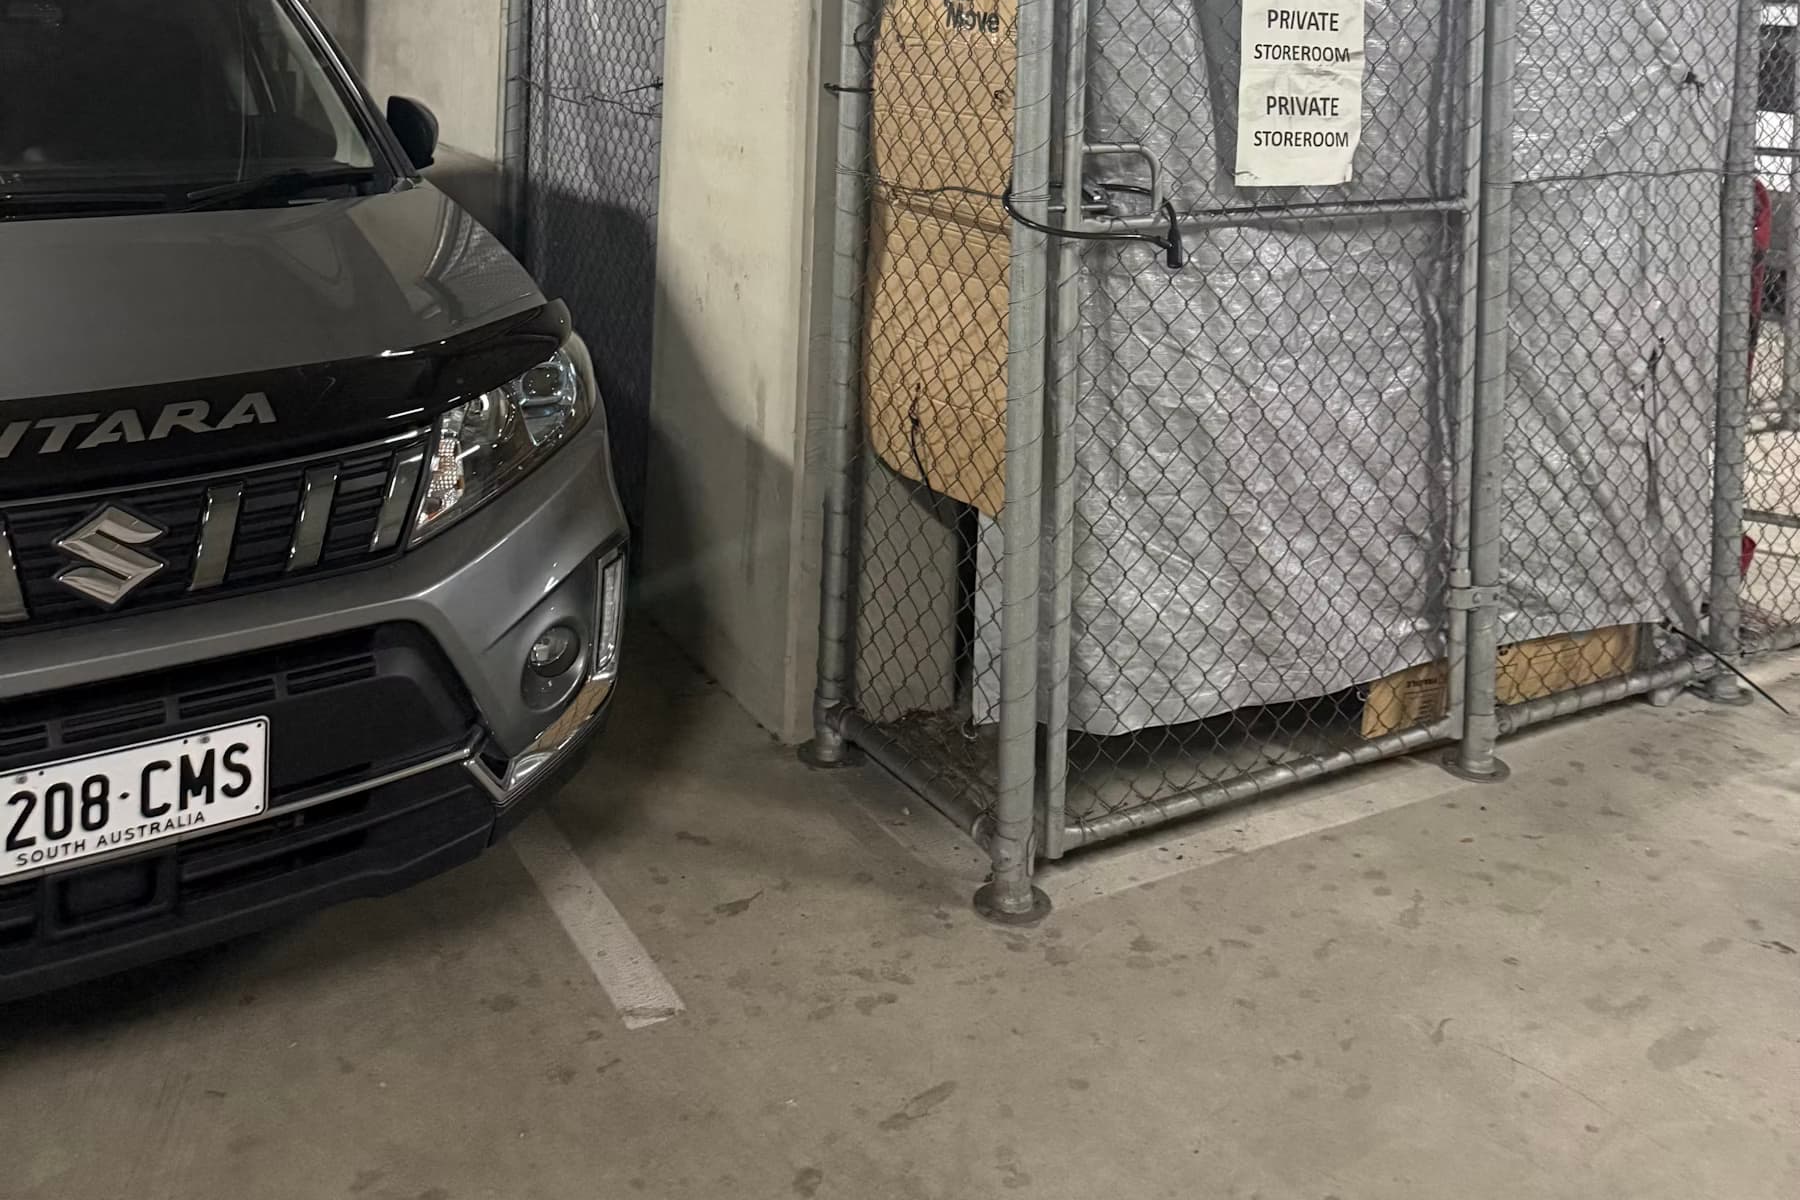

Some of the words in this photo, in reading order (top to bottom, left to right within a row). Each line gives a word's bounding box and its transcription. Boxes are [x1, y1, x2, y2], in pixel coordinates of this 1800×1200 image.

[1267, 9, 1339, 32] PRIVATE
[1253, 43, 1351, 62] STOREROOM
[1266, 96, 1339, 116] PRIVATE
[1253, 131, 1349, 148] STOREROOM
[0, 391, 277, 459] ITARA
[16, 837, 86, 867] SOUTH
[96, 810, 206, 848] AUSTRALIA
